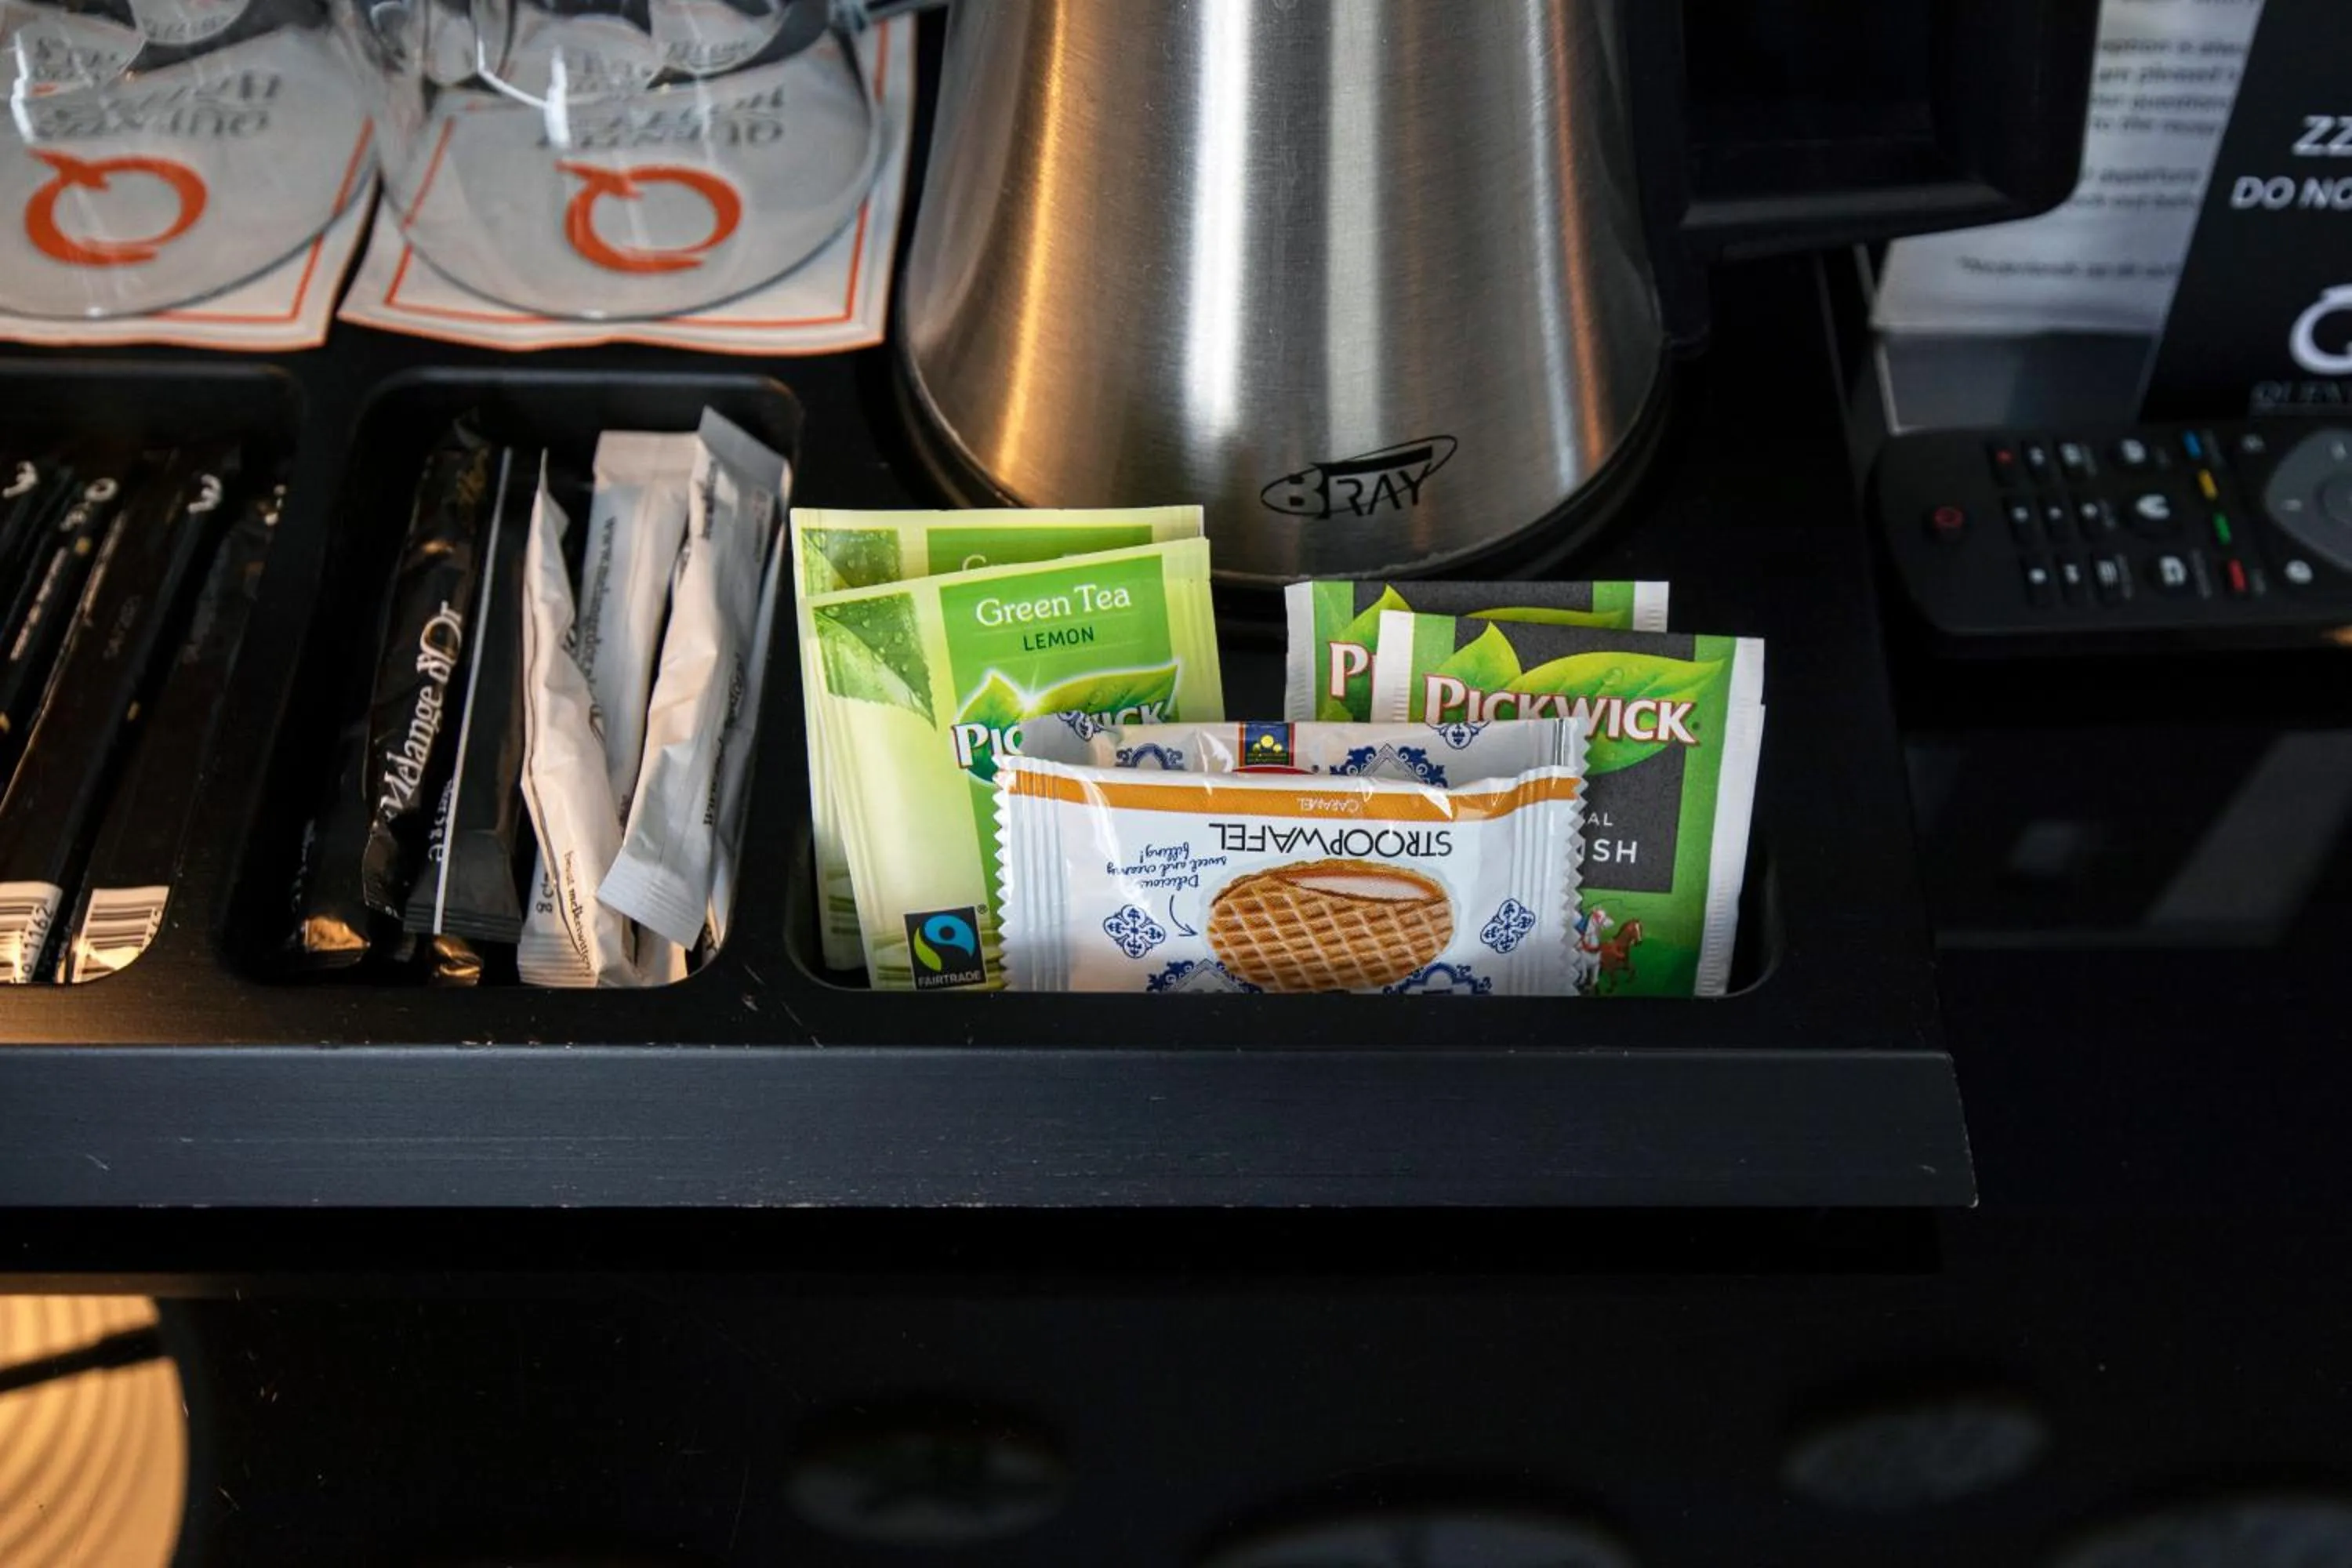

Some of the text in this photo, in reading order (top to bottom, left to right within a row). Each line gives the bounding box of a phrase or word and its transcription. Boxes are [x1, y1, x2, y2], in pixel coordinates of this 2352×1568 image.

[2230, 176, 2294, 209] DO
[1275, 448, 1436, 519] BRAY
[975, 583, 1131, 628] Green Tea
[1022, 626, 1094, 652] LEMON
[1296, 796, 1360, 814] CARAMEL
[1208, 822, 1453, 858] STROOPWAFEL
[1138, 841, 1190, 864] filling!
[1189, 856, 1228, 873] sweet
[1158, 861, 1187, 877] and
[916, 970, 982, 988] FAIRTRADE
